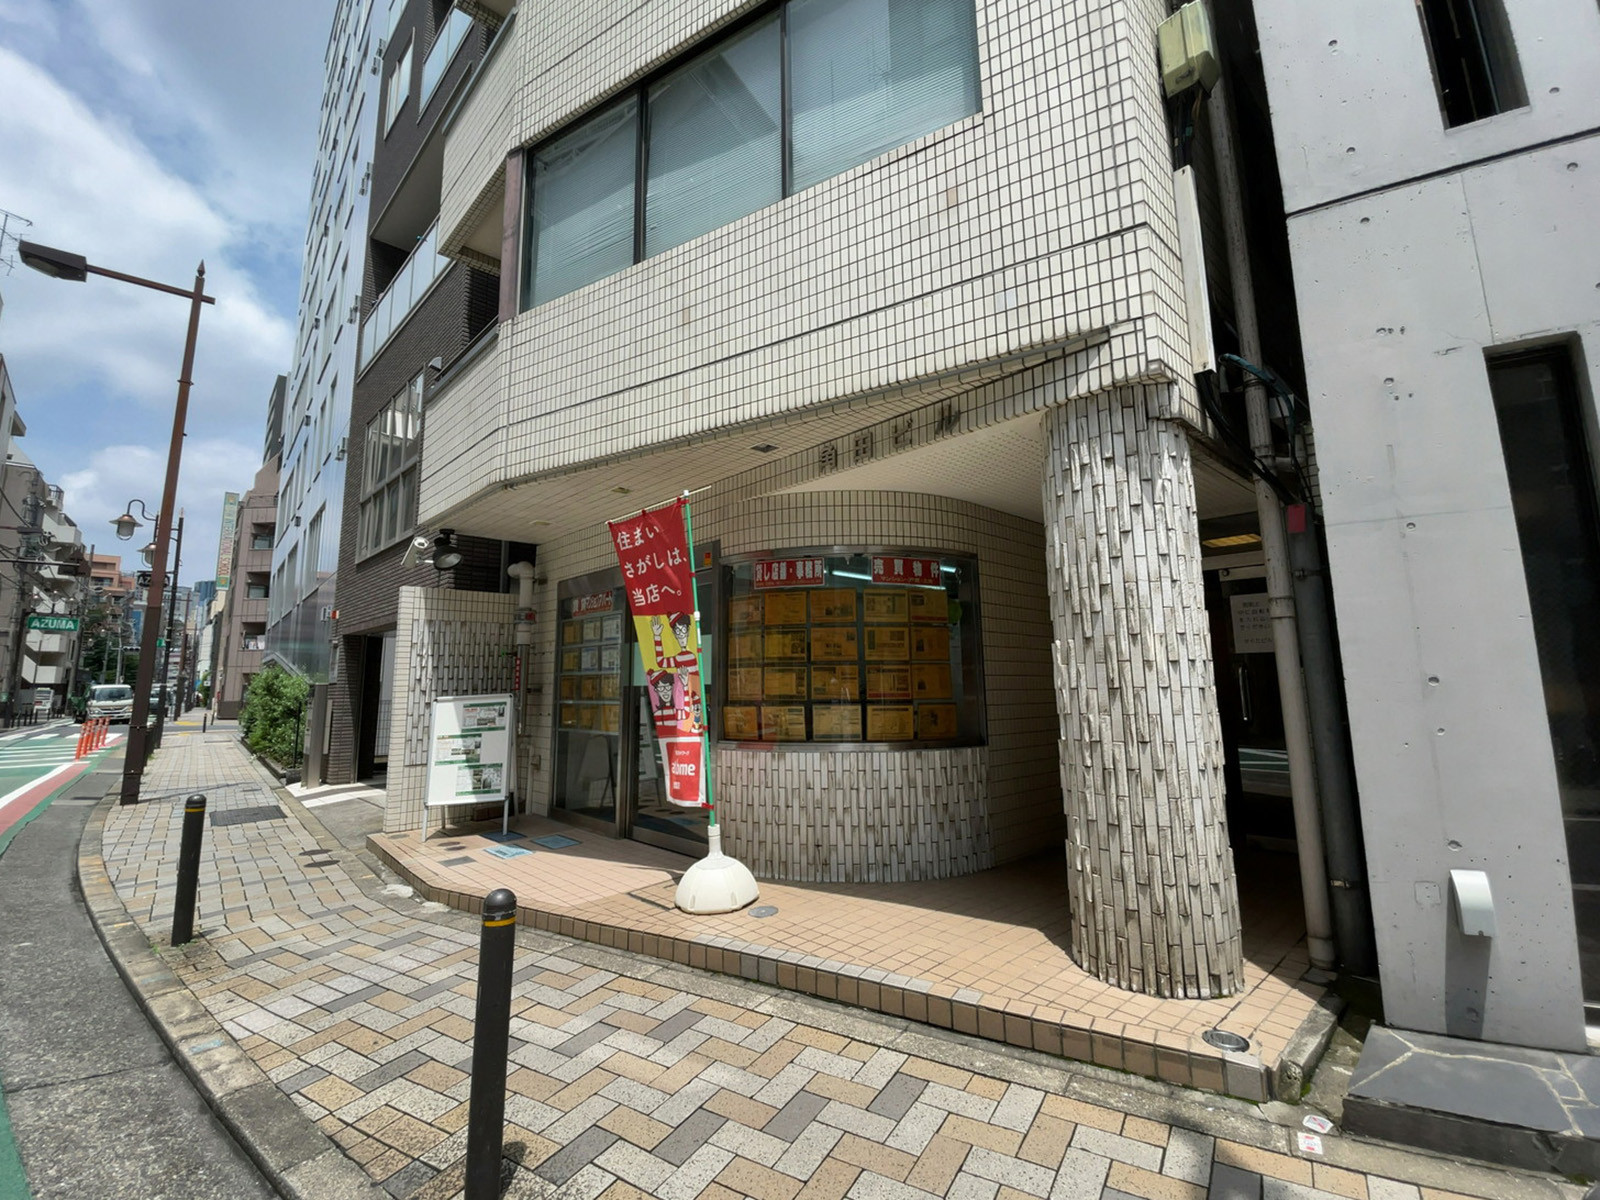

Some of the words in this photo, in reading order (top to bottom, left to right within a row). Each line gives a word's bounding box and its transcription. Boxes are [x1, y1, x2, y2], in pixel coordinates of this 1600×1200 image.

[617, 525, 660, 551] 住まい
[624, 547, 687, 578] さがしは、
[632, 583, 682, 607] 当店へ。
[30, 619, 75, 630] AZUMA
